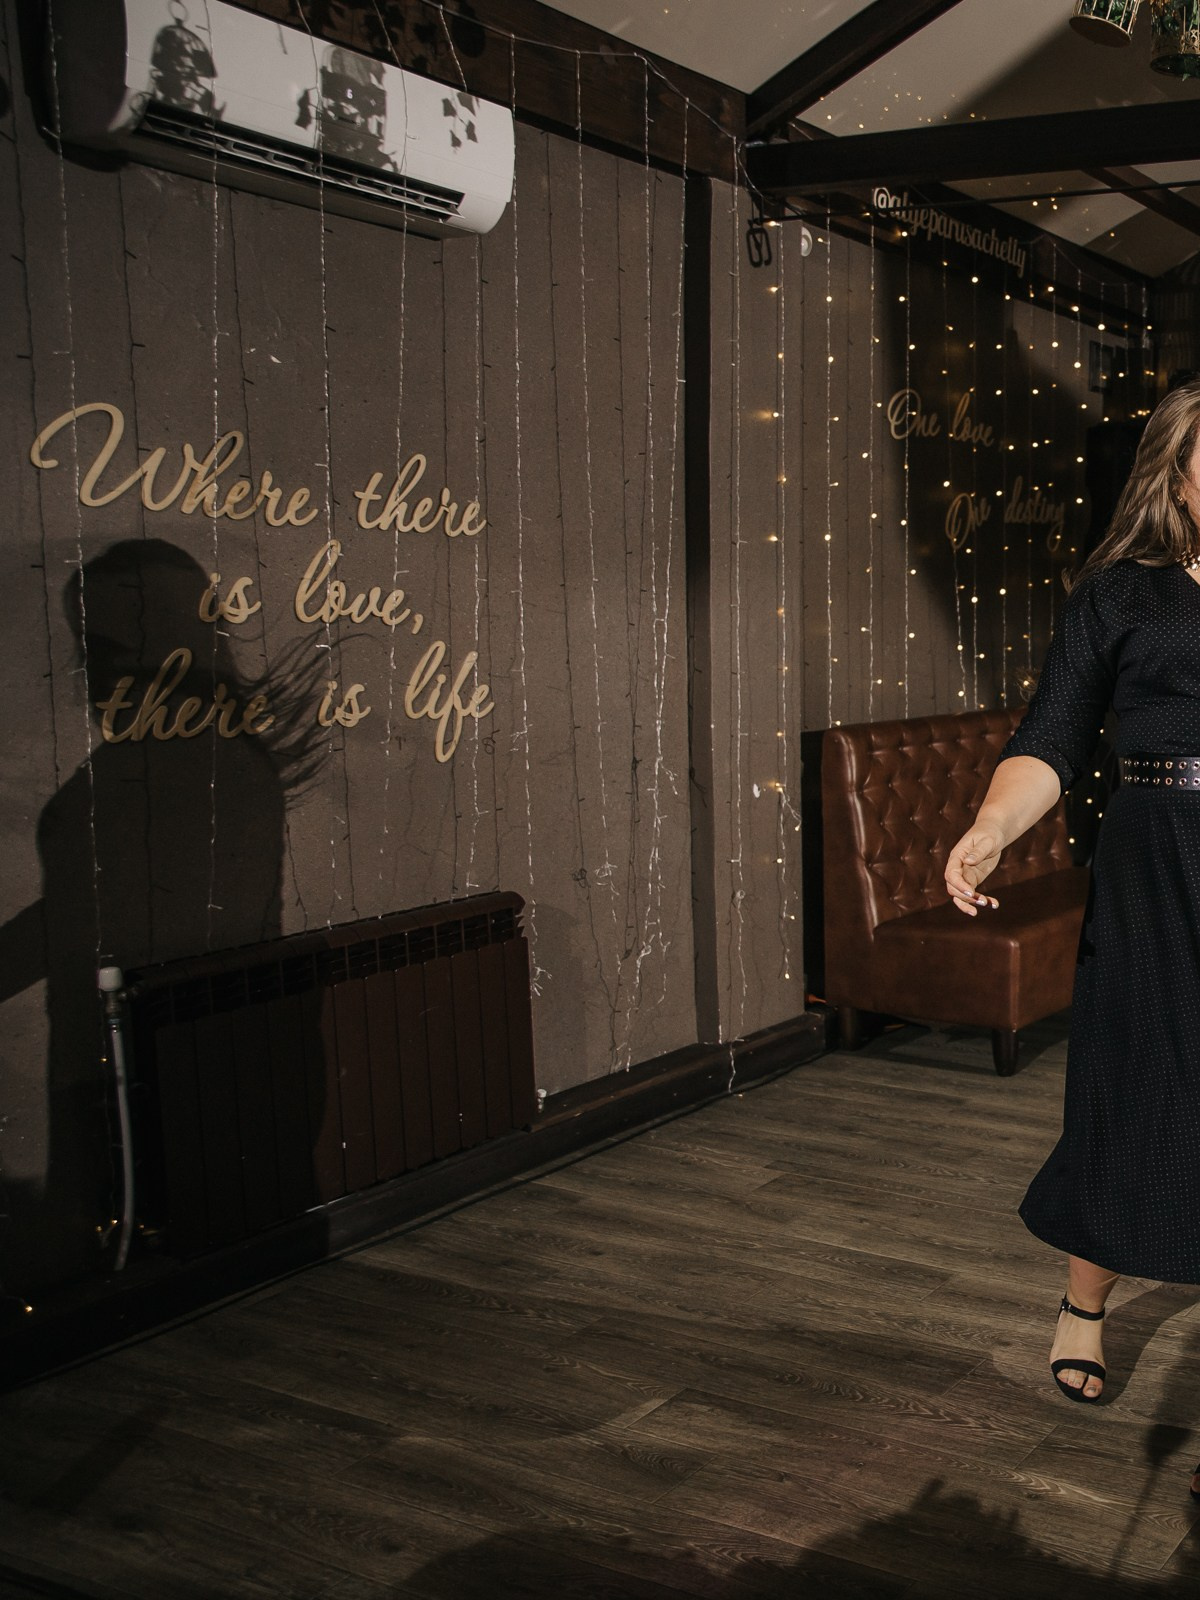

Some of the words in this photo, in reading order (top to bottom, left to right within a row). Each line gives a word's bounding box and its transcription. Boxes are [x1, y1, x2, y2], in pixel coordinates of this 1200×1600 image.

[887, 388, 942, 440] One
[952, 391, 995, 448] love
[29, 402, 320, 529] Where
[353, 453, 488, 538] there
[944, 492, 992, 551] One
[198, 572, 262, 624] is
[294, 538, 425, 635] love,
[95, 647, 277, 744] there
[318, 679, 372, 728] is
[403, 640, 496, 764] life
